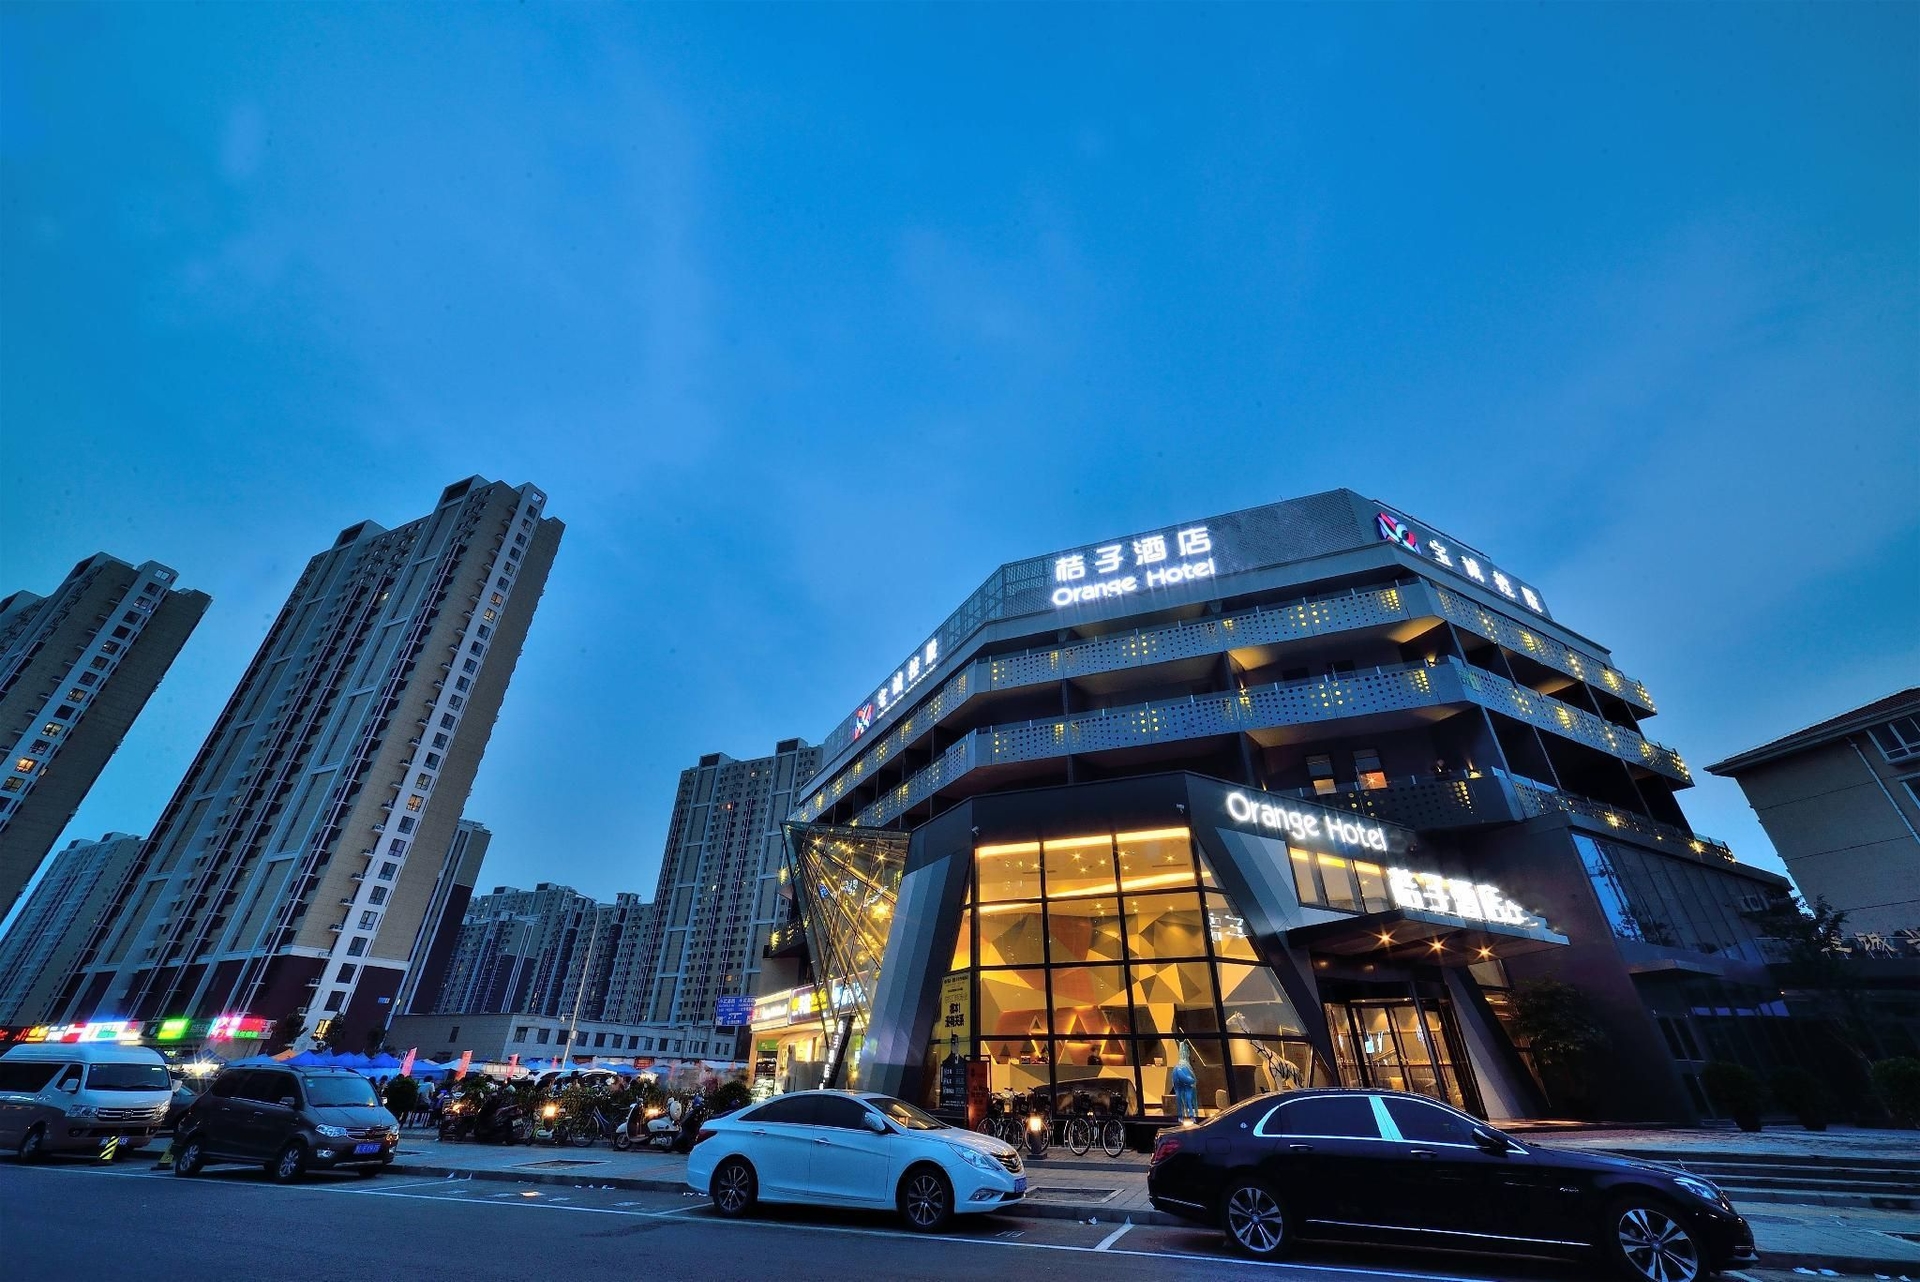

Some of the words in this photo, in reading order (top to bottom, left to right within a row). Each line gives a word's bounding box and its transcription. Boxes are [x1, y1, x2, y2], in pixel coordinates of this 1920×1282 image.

[1055, 526, 1211, 581] 桔子酒店
[1052, 576, 1137, 606] Orange
[1147, 558, 1216, 587] Hotel
[1226, 791, 1320, 840] Orange
[1325, 815, 1387, 851] Hotel
